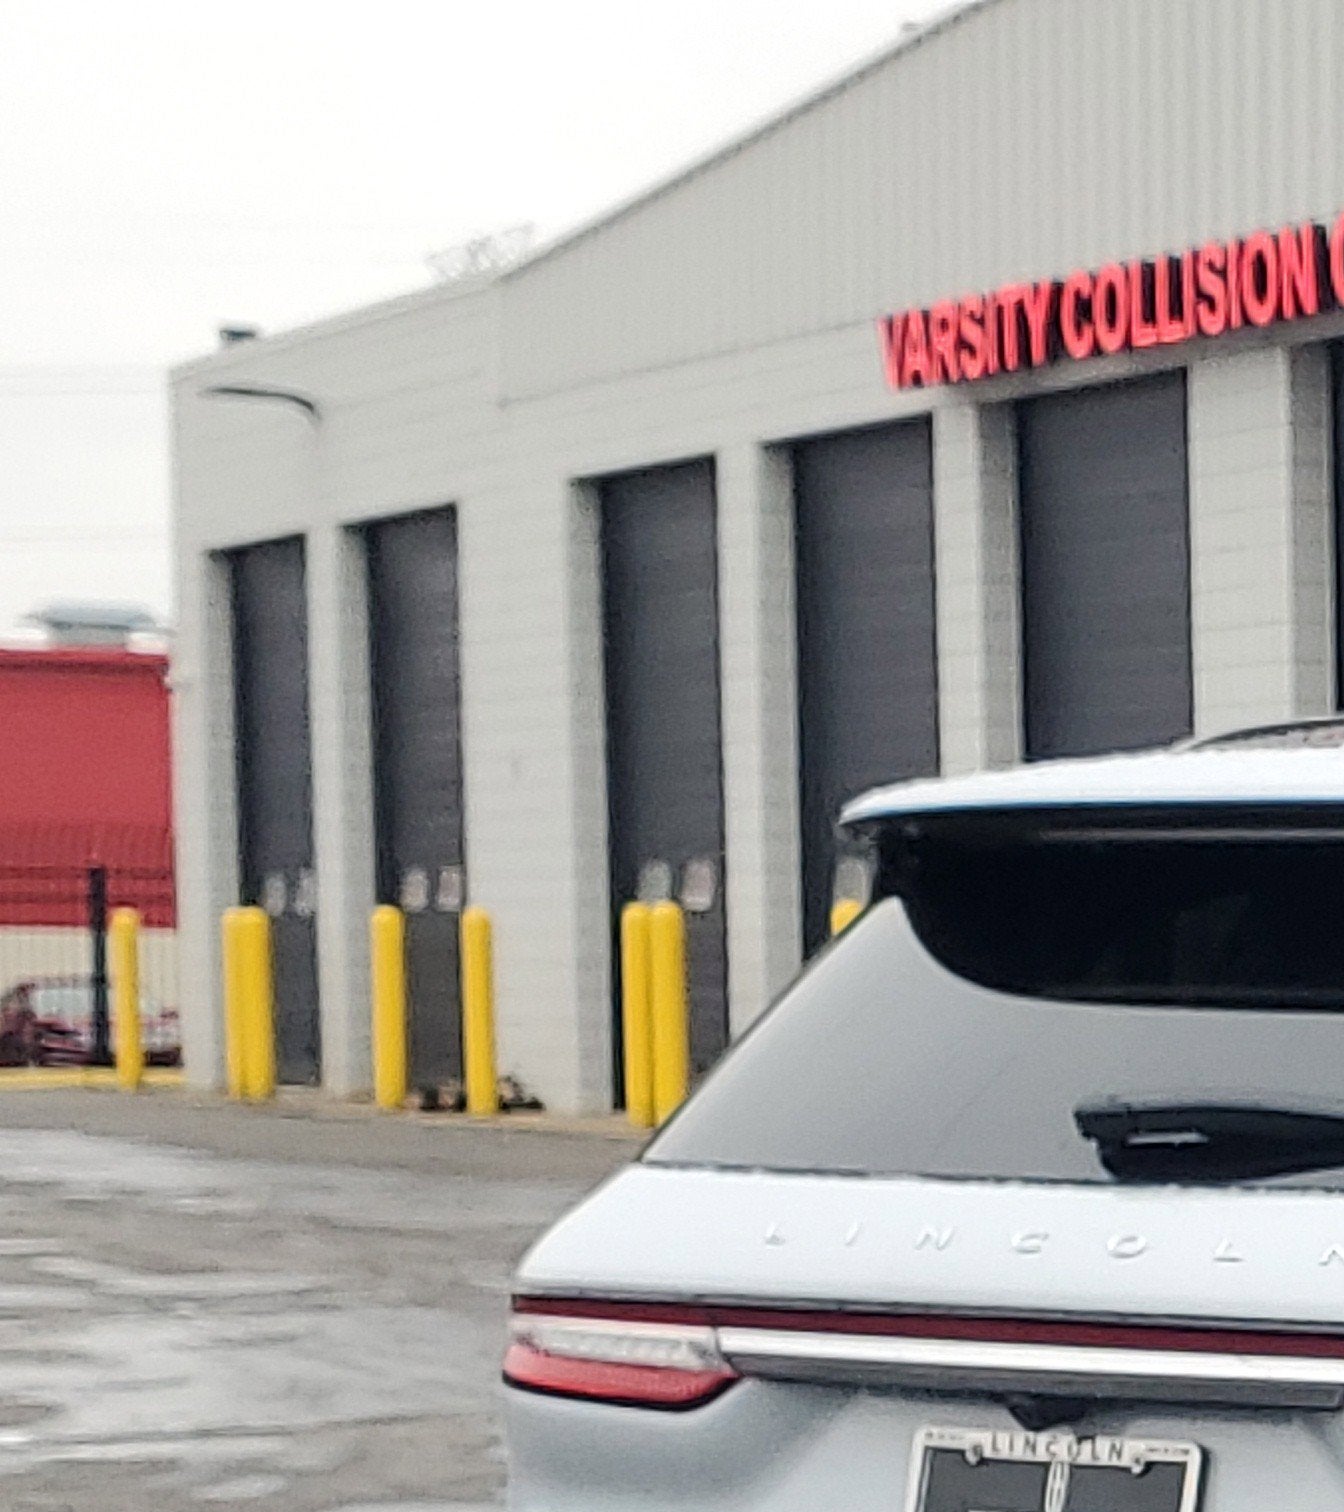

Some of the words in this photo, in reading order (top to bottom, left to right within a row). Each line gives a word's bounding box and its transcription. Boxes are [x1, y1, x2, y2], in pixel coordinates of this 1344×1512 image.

[880, 279, 1054, 391] VARSITY
[1060, 226, 1319, 359] COLLISION
[991, 1431, 1123, 1462] LINCOLN
